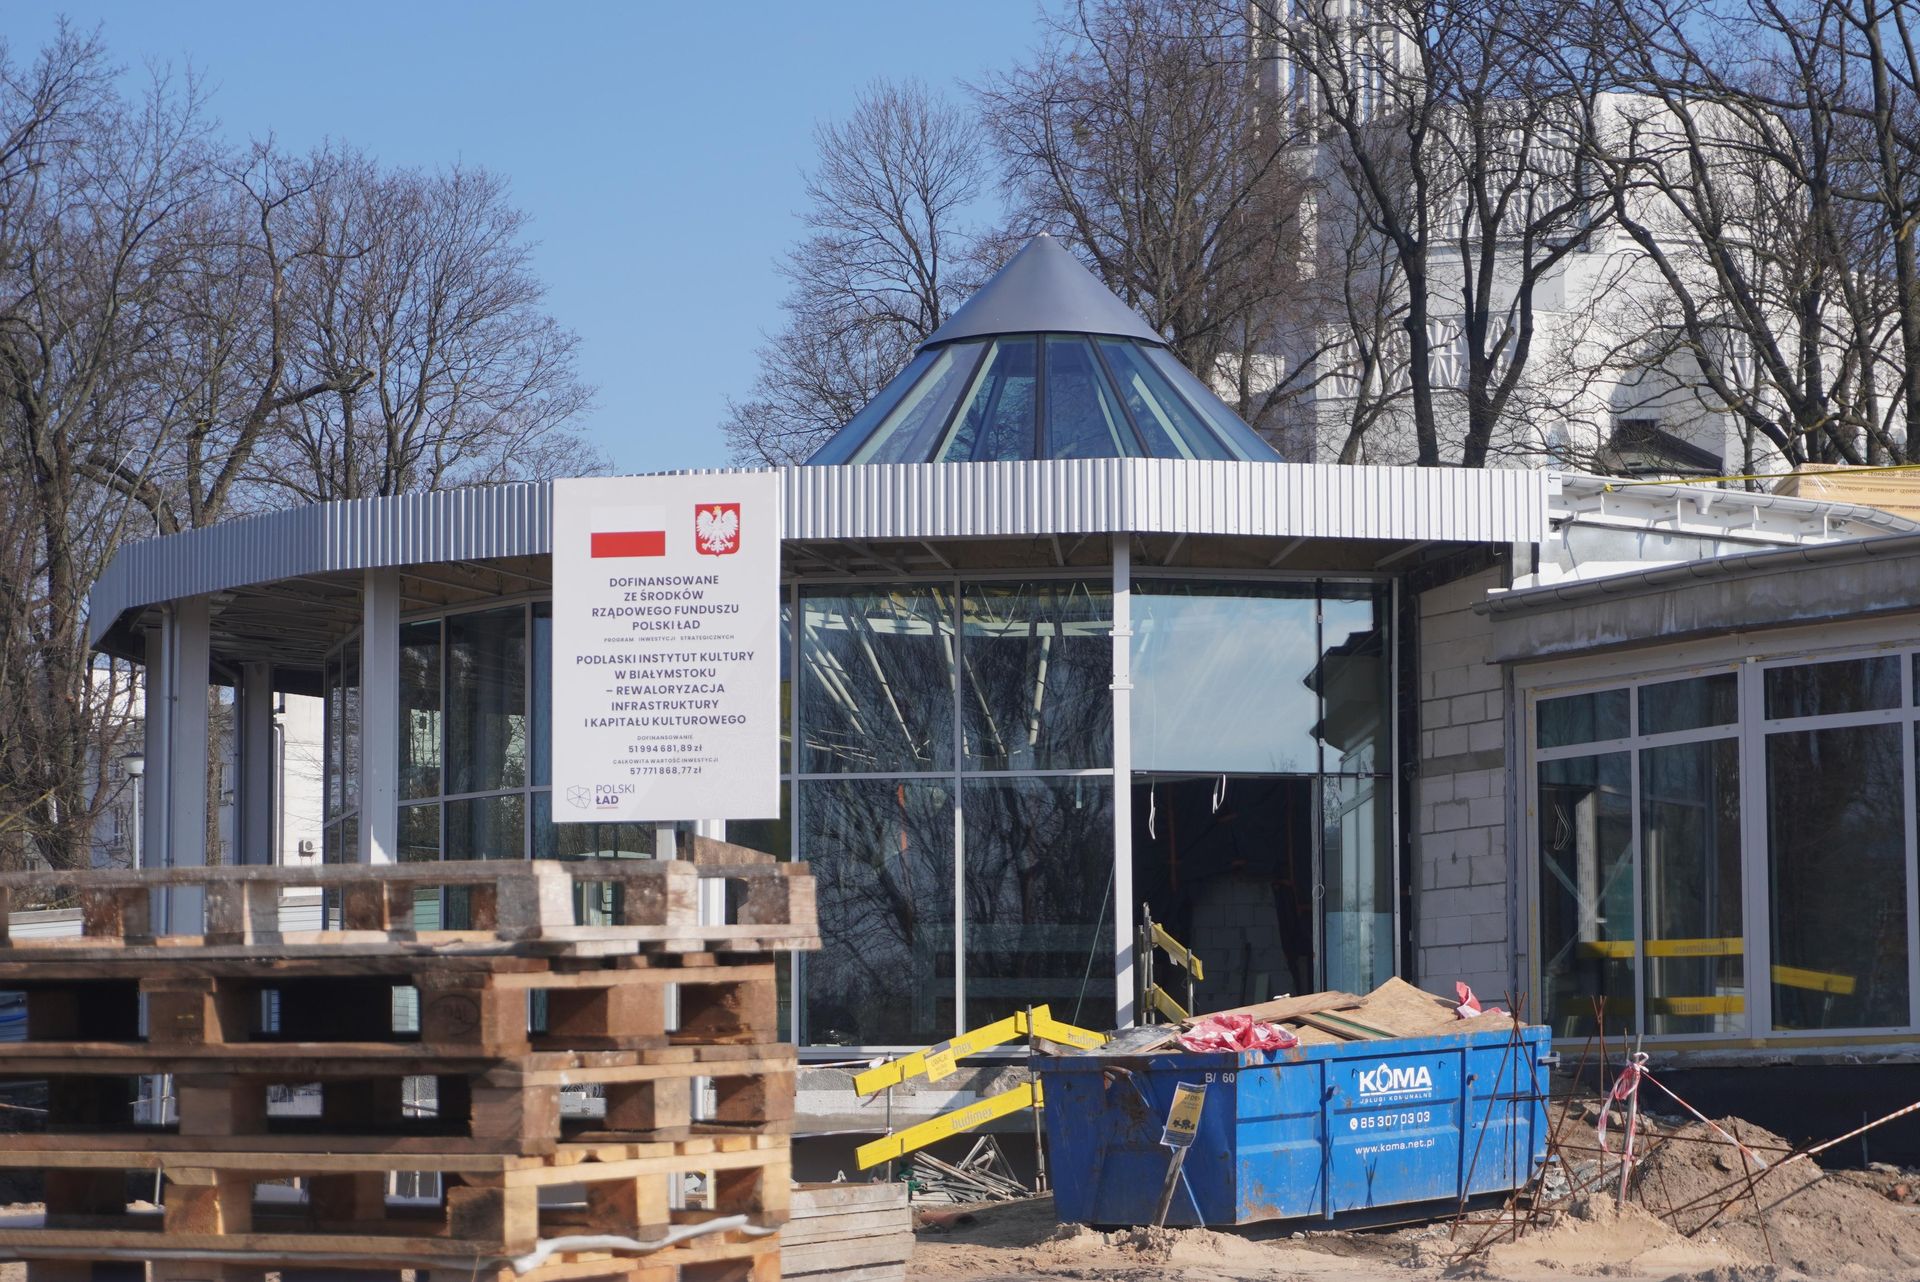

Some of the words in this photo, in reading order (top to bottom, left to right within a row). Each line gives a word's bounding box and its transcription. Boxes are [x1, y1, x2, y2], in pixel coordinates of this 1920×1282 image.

[610, 575, 719, 587] DOFINANSOWANE
[624, 592, 637, 602] ZE
[640, 588, 704, 601] ŚRODKÓW
[592, 606, 672, 619] RZĄDOWEGO
[674, 604, 739, 615] FUNDUSZU
[632, 621, 674, 631] POLSKI
[677, 620, 700, 630] ŁAD
[576, 654, 636, 665] PODLASKI
[639, 653, 697, 663] INSTYTUT
[699, 651, 755, 662] KULTURY
[614, 670, 626, 680] W
[629, 668, 716, 680] BIAŁYMSTOKU
[616, 684, 725, 695] REWALORYZACJA
[611, 699, 719, 711] INFRASTRUKTURY
[584, 718, 588, 727] I
[590, 717, 650, 728] KAPITAŁU
[652, 714, 746, 726] KULTUROWEGO
[596, 783, 635, 794] POLSKI
[595, 795, 619, 805] ŁAD
[1222, 1073, 1235, 1083] 60
[1359, 1063, 1432, 1092] KOMA
[951, 1107, 992, 1129] budimex
[1360, 1117, 1374, 1128] 85
[1377, 1115, 1398, 1127] 307
[1400, 1113, 1414, 1124] 03
[1416, 1111, 1430, 1123] 03
[1355, 1138, 1435, 1155] www.koma.net.pl
